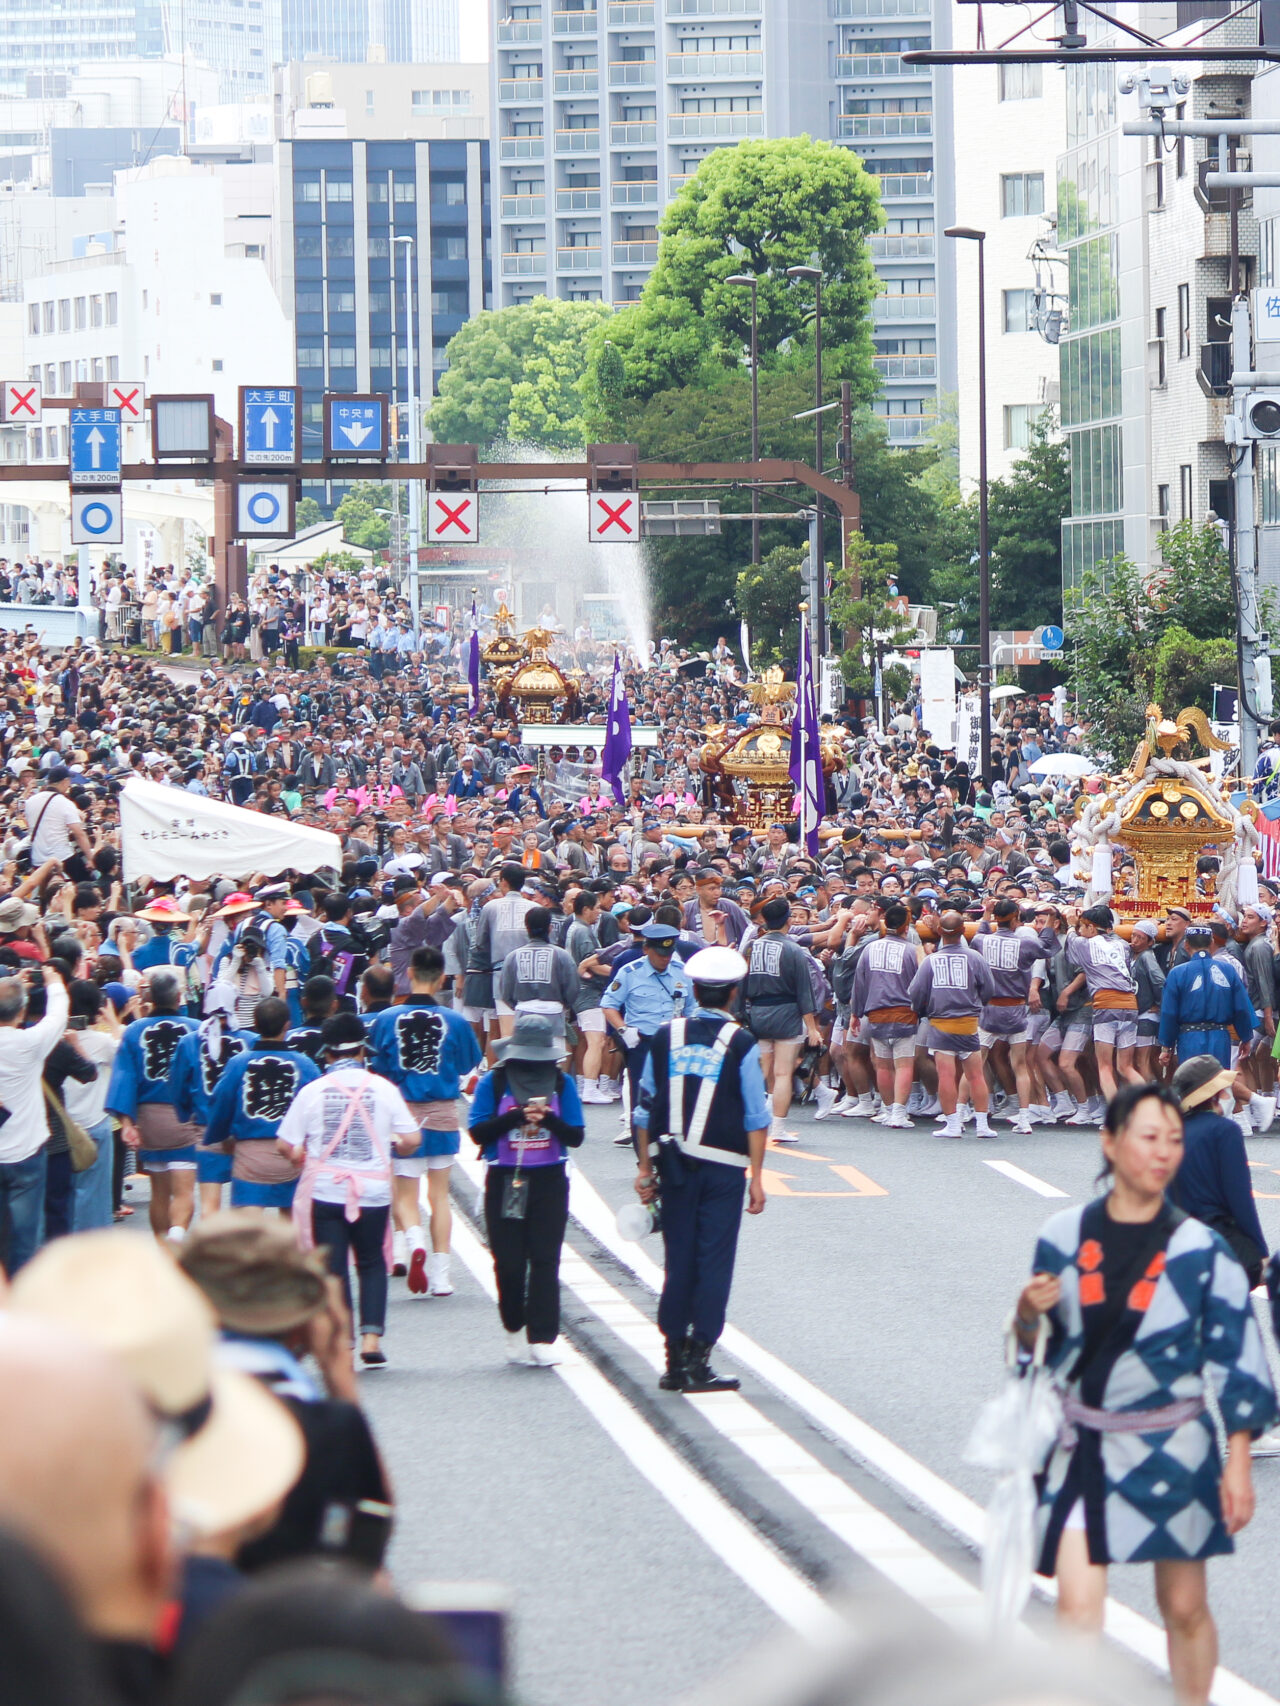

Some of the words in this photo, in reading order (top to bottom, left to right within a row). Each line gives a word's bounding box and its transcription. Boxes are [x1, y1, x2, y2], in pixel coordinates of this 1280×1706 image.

[248, 390, 291, 402] 大手町
[73, 410, 117, 422] 大手町
[74, 474, 119, 482] この先200m
[140, 829, 231, 841] セレモニーみやざき
[672, 1046, 722, 1064] POLICE
